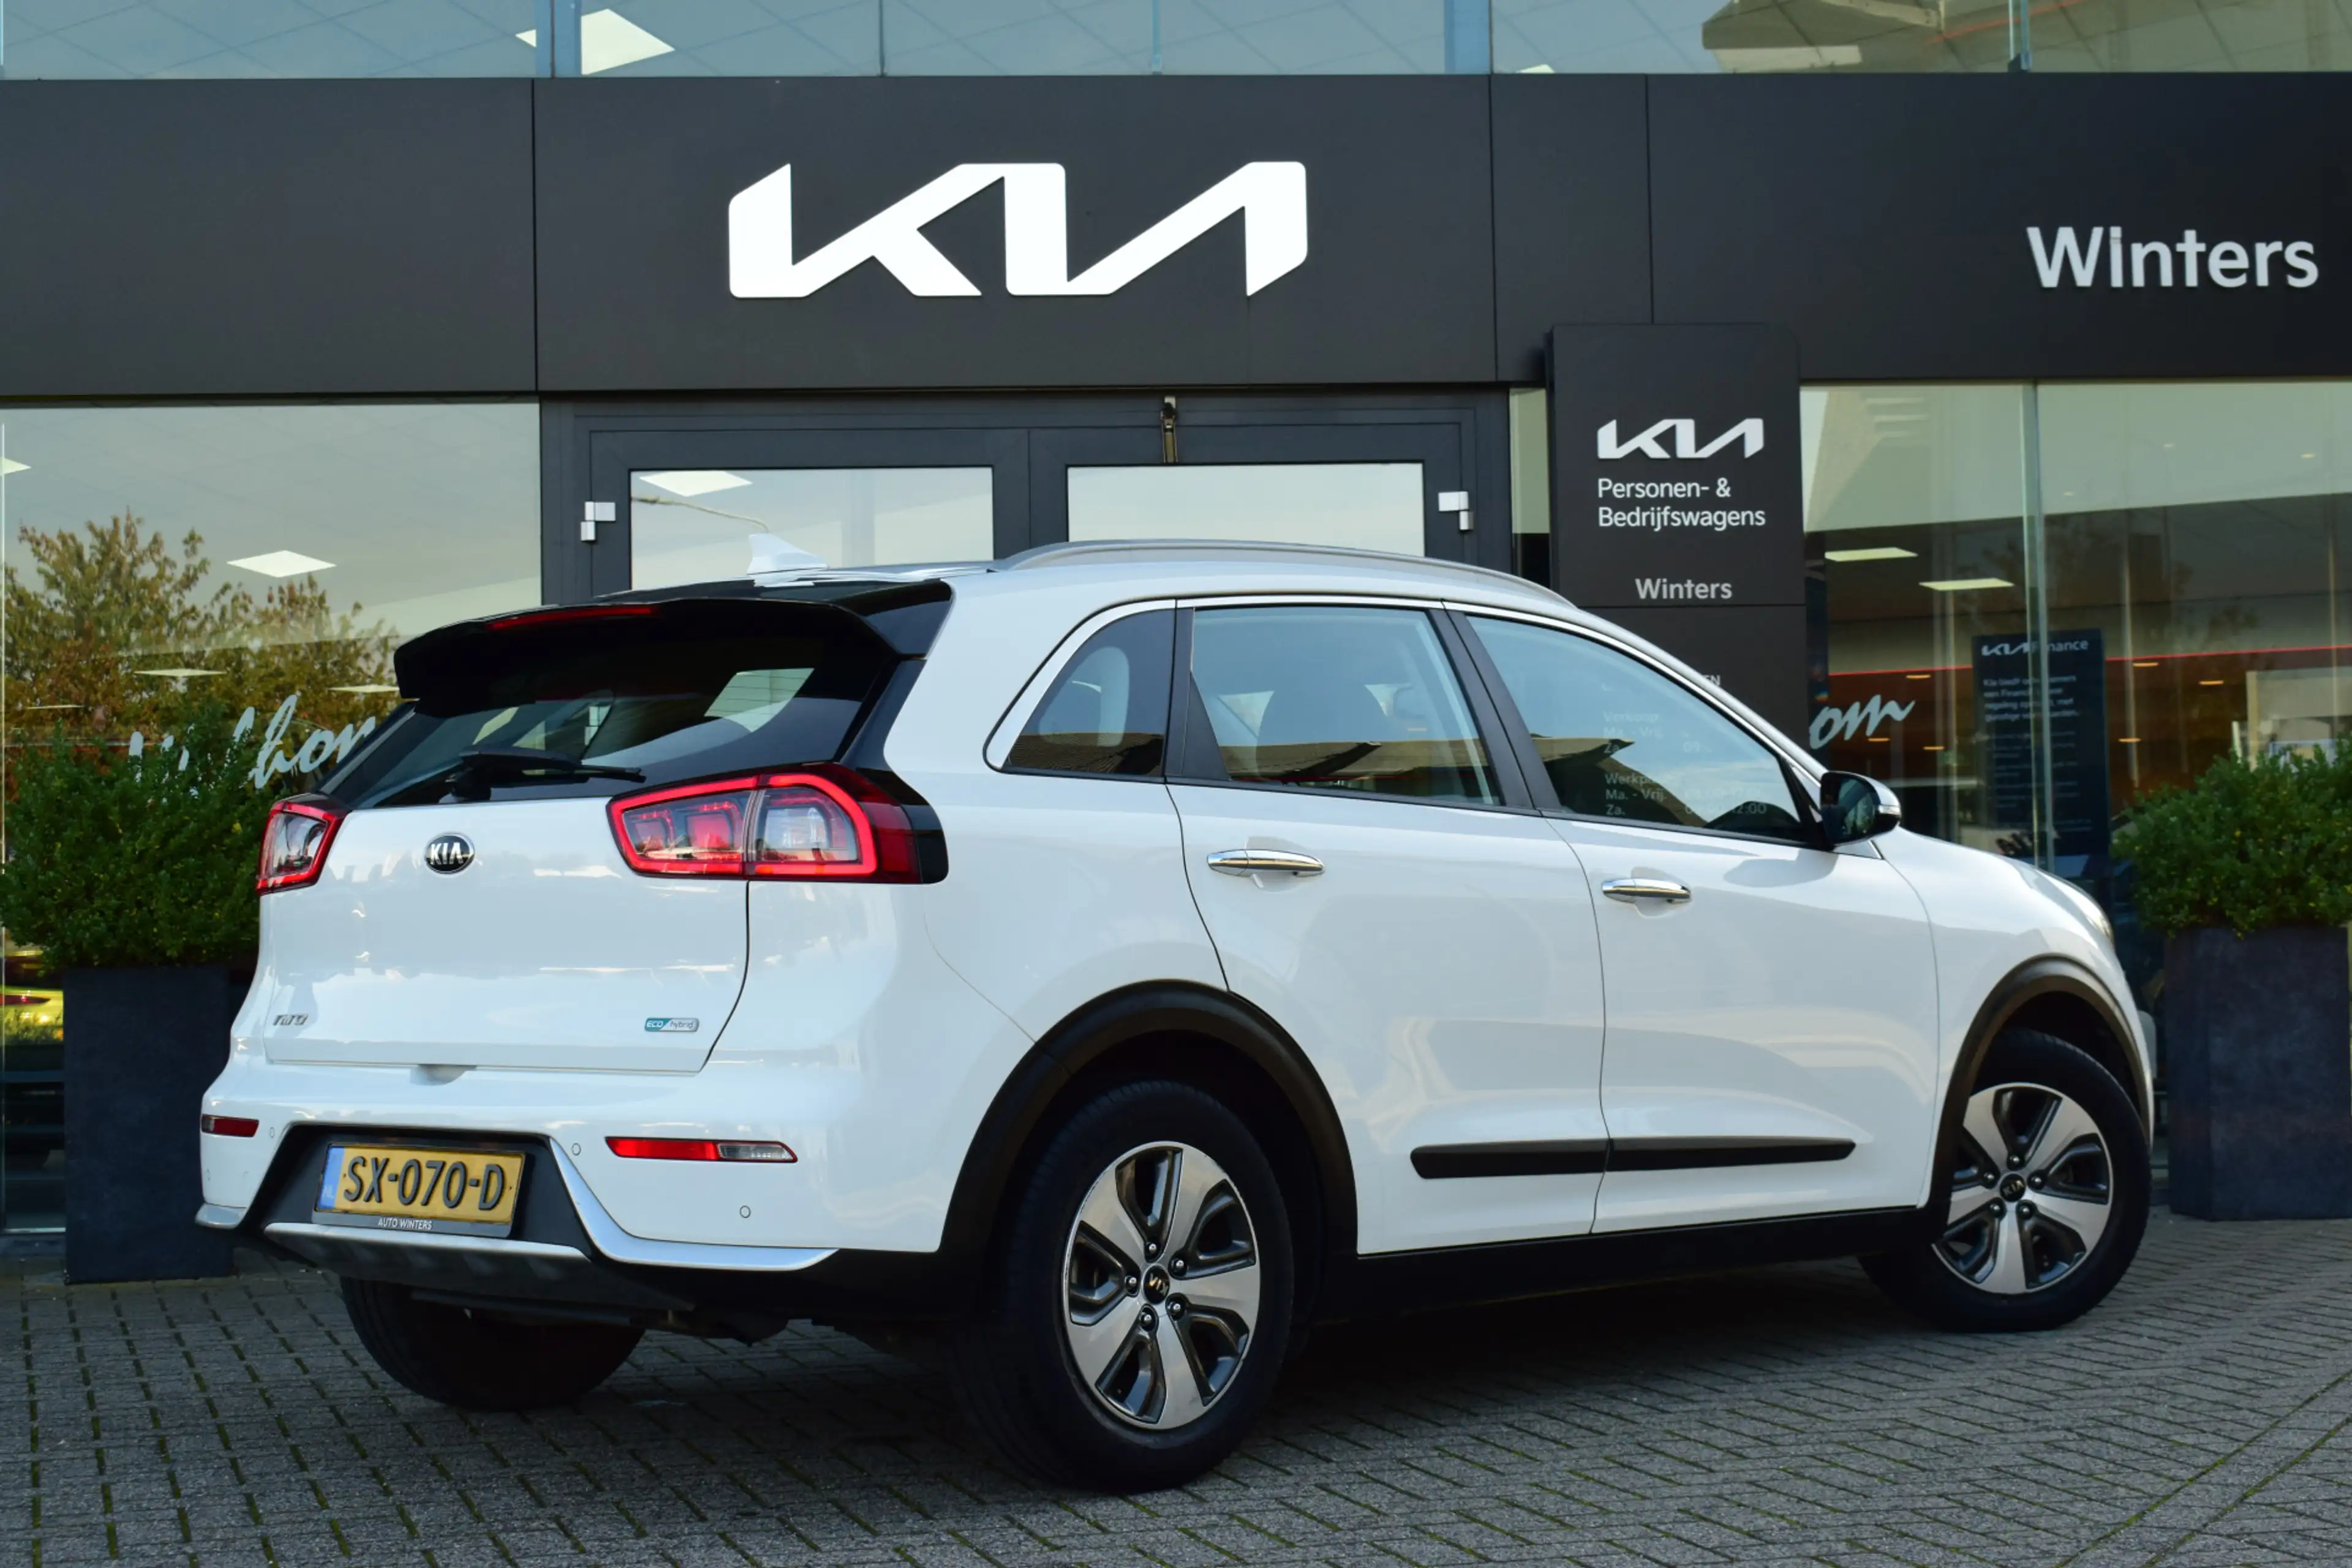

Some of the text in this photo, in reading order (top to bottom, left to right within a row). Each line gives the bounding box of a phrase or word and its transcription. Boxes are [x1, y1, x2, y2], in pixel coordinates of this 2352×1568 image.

[2026, 226, 2320, 288] Winters
[1597, 477, 1732, 498] Personen- &
[1597, 505, 1766, 531] Bedrijfswagens
[1635, 578, 1733, 600] Winters
[430, 842, 464, 865] KIA
[343, 1156, 506, 1211] SX-070-D
[378, 1218, 432, 1231] AUTO WINTERS
